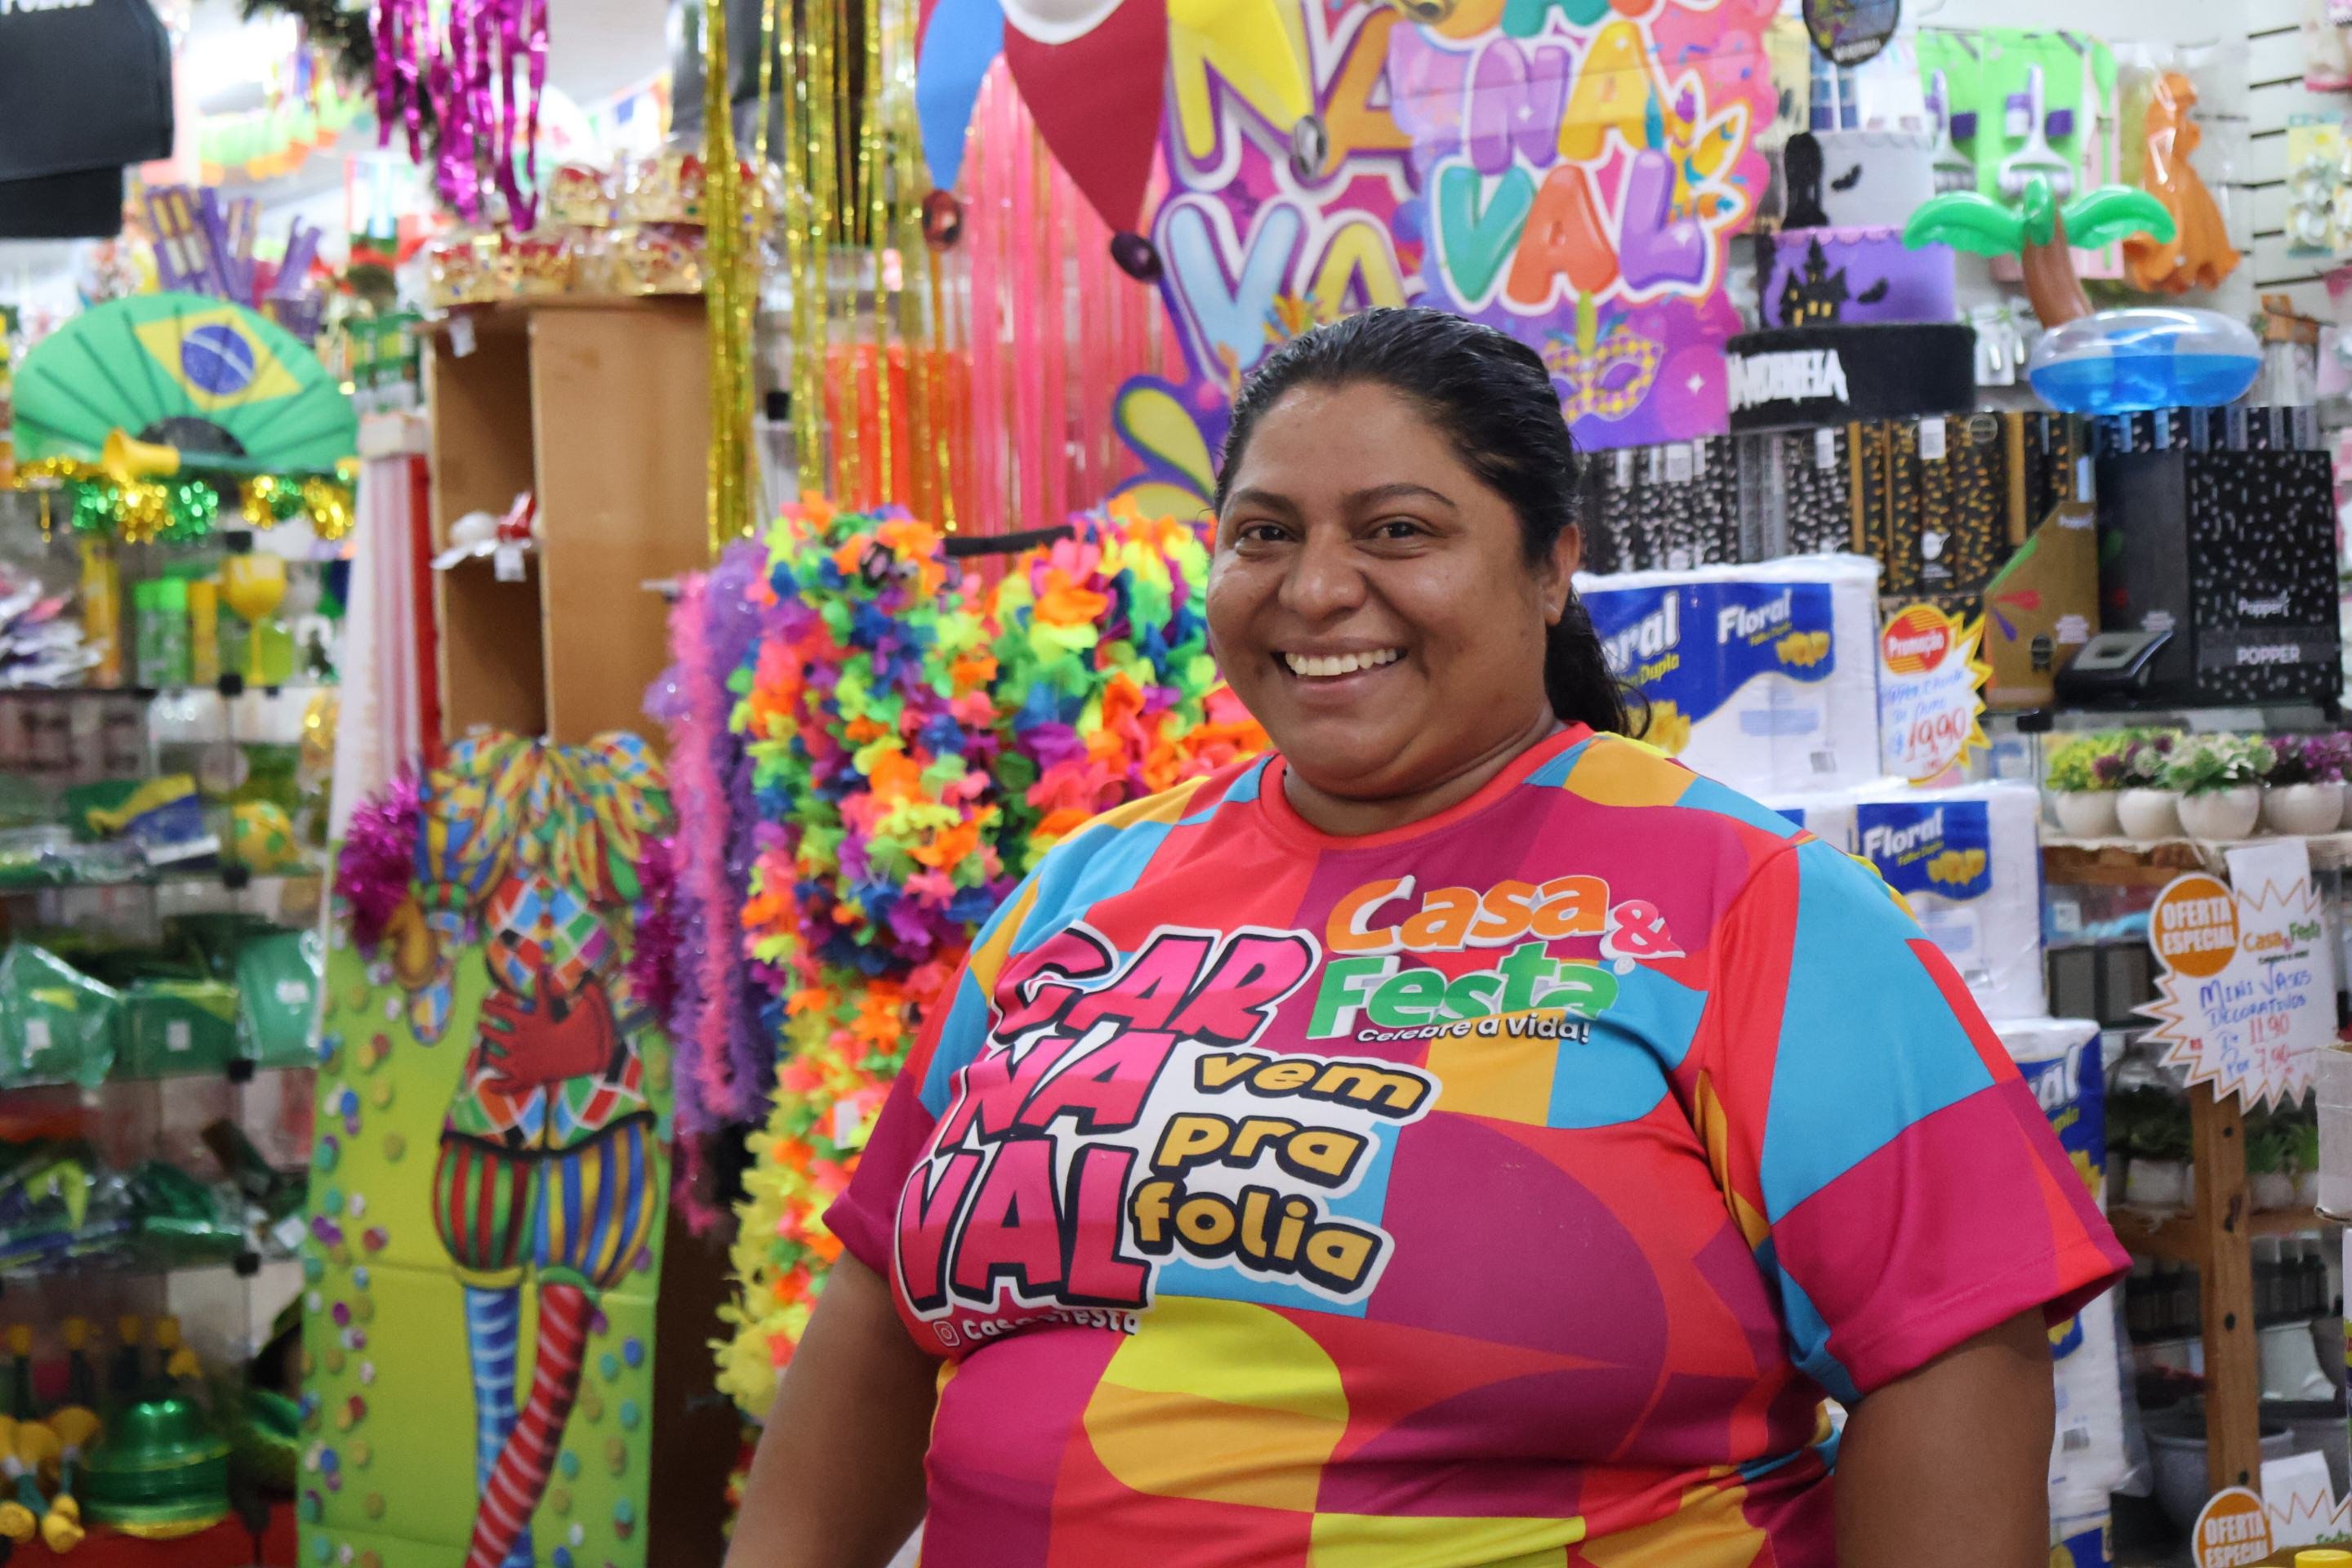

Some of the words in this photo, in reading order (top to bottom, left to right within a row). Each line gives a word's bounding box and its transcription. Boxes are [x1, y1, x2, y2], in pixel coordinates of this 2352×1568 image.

[1471, 21, 1664, 176] NA
[1439, 150, 1706, 305] VAL
[1717, 586, 1793, 645] Floral
[2236, 644, 2301, 665] POPPER
[1863, 806, 1944, 860] Floral
[1325, 875, 1610, 955] Casa
[1600, 899, 1686, 959] &
[2161, 924, 2237, 956] ESPECIAL
[2162, 895, 2234, 930] OFERTA
[993, 925, 1314, 1048] CAR
[1307, 941, 1619, 1040] Festa
[1356, 1018, 1480, 1044] Celebre
[1477, 1018, 1503, 1037] a
[1502, 1013, 1592, 1044] vida!
[935, 1030, 1183, 1153] NA
[1194, 1052, 1432, 1119] vem
[1150, 1112, 1370, 1189] pra
[898, 1134, 1152, 1312] VAL
[1128, 1176, 1383, 1294] folia
[2205, 1509, 2267, 1547] OFERTA
